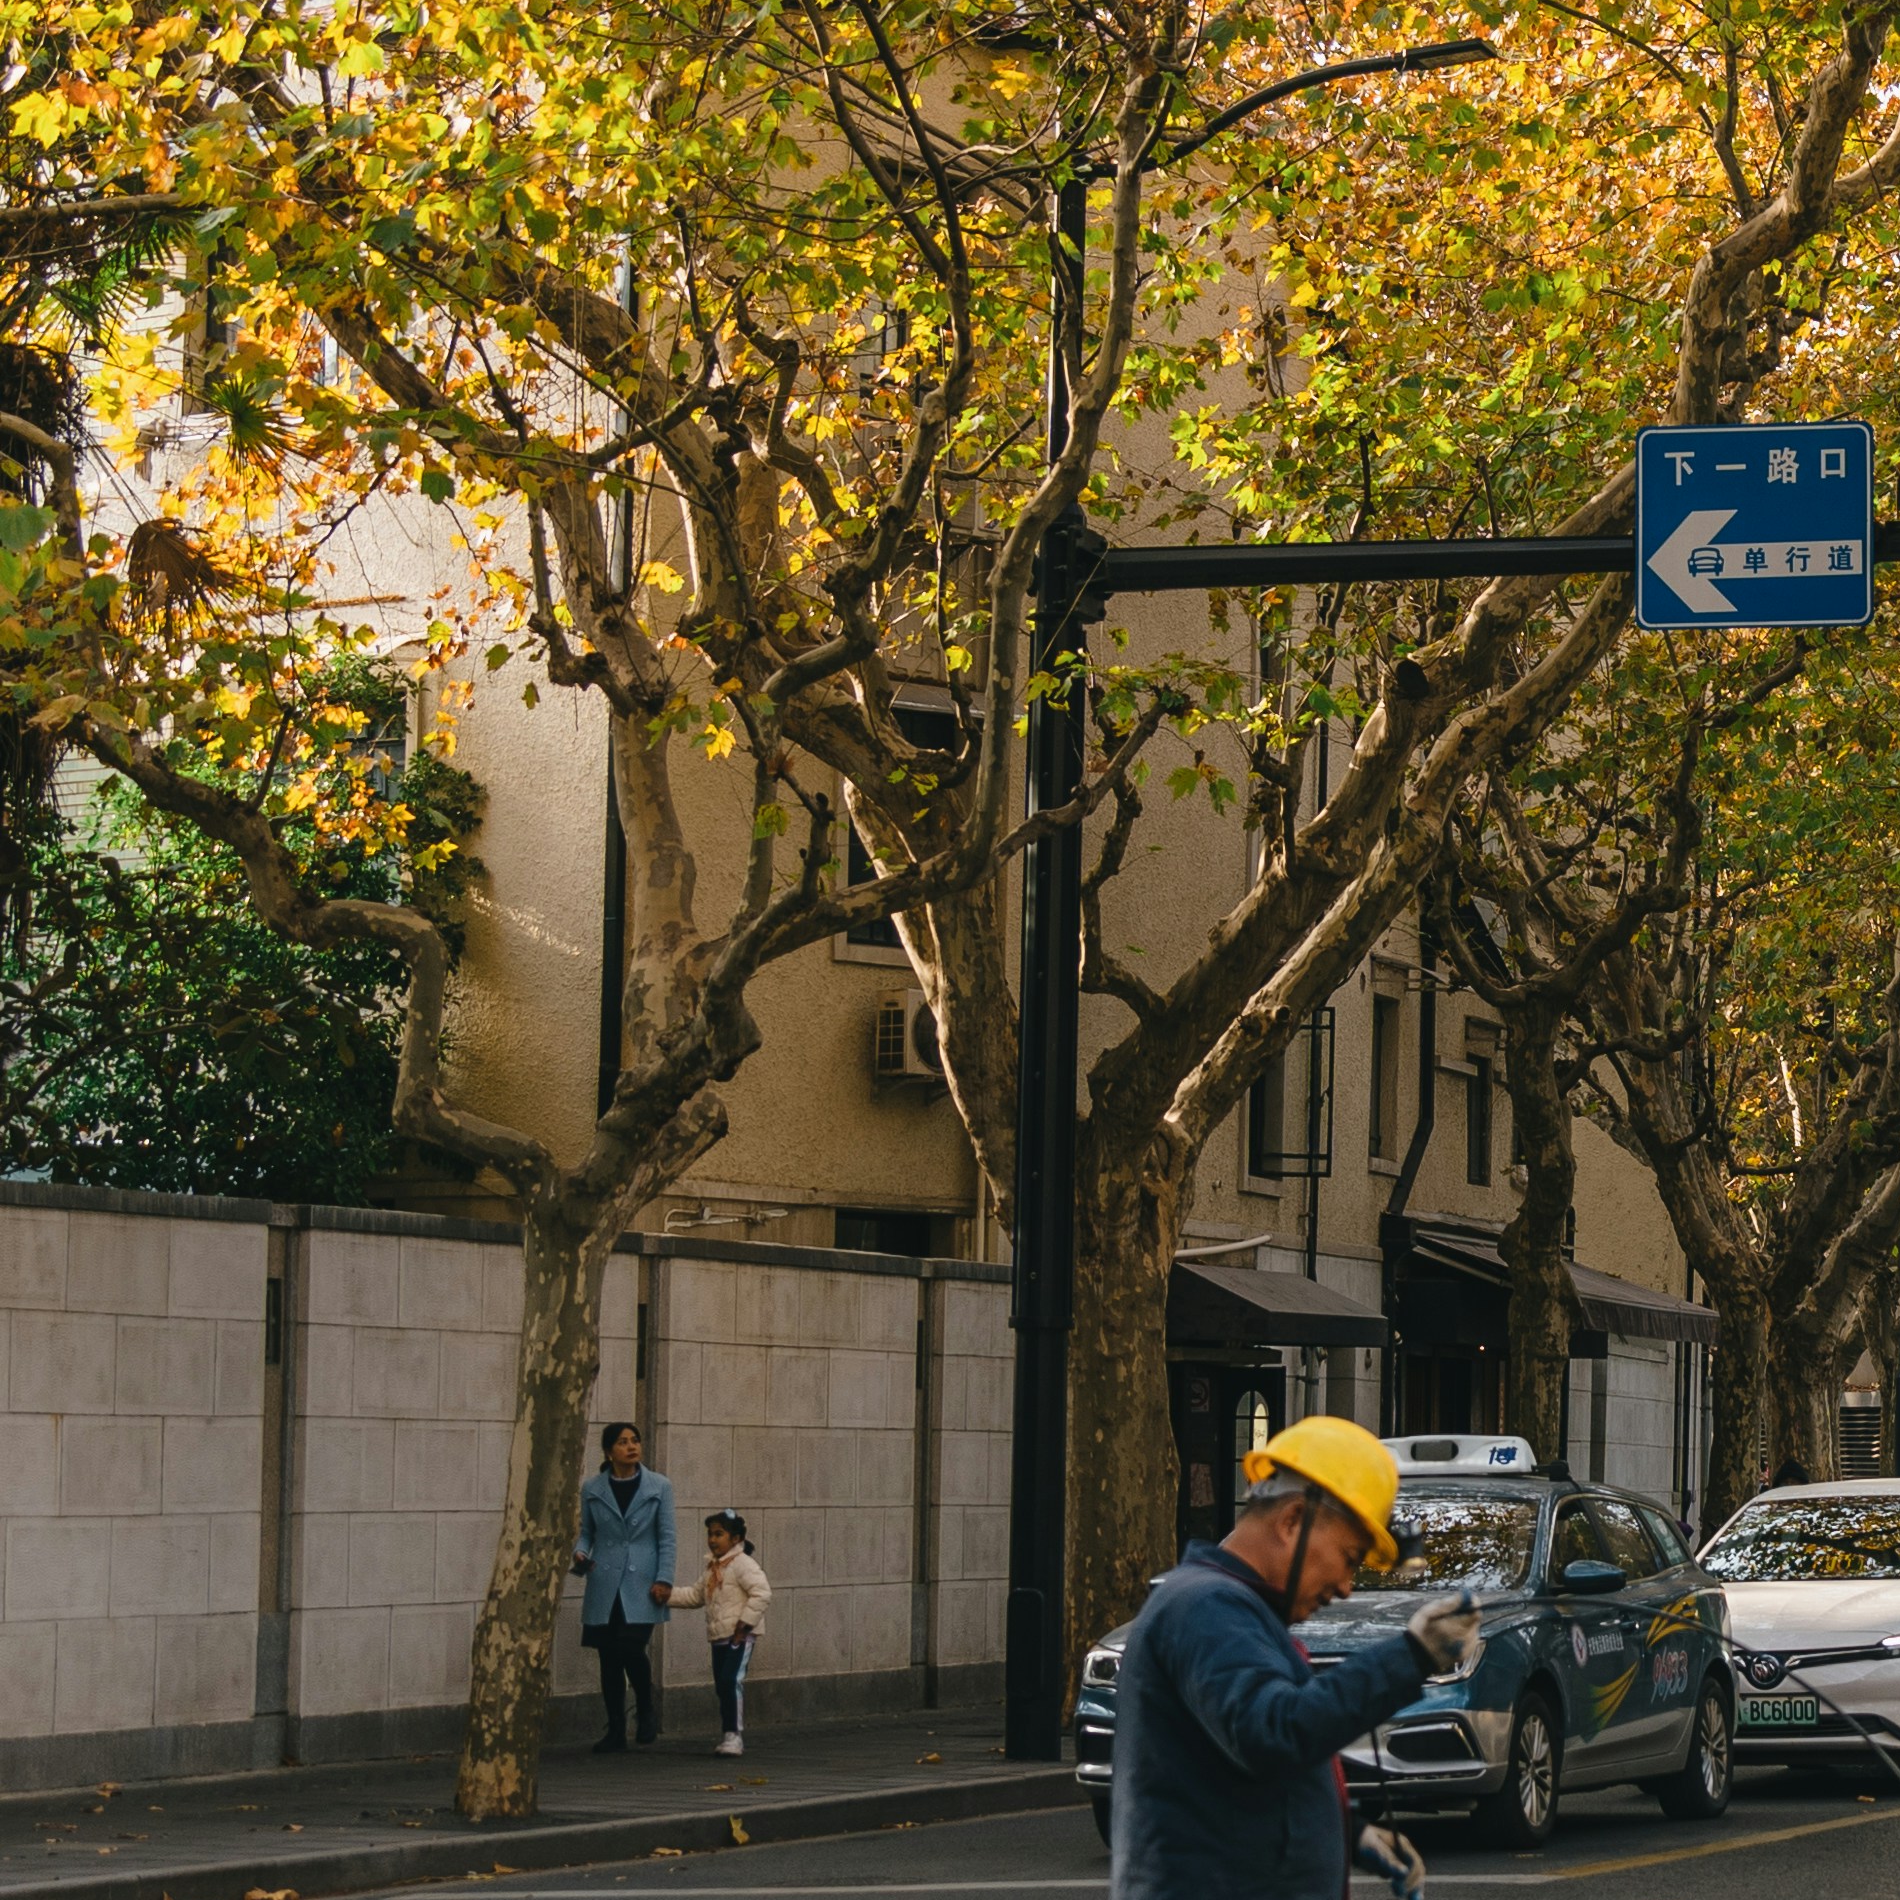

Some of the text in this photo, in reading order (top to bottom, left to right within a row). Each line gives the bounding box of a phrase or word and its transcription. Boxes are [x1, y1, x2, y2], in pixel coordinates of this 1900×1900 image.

[1663, 446, 1846, 486] 下一路口
[1742, 544, 1855, 574] 单行道
